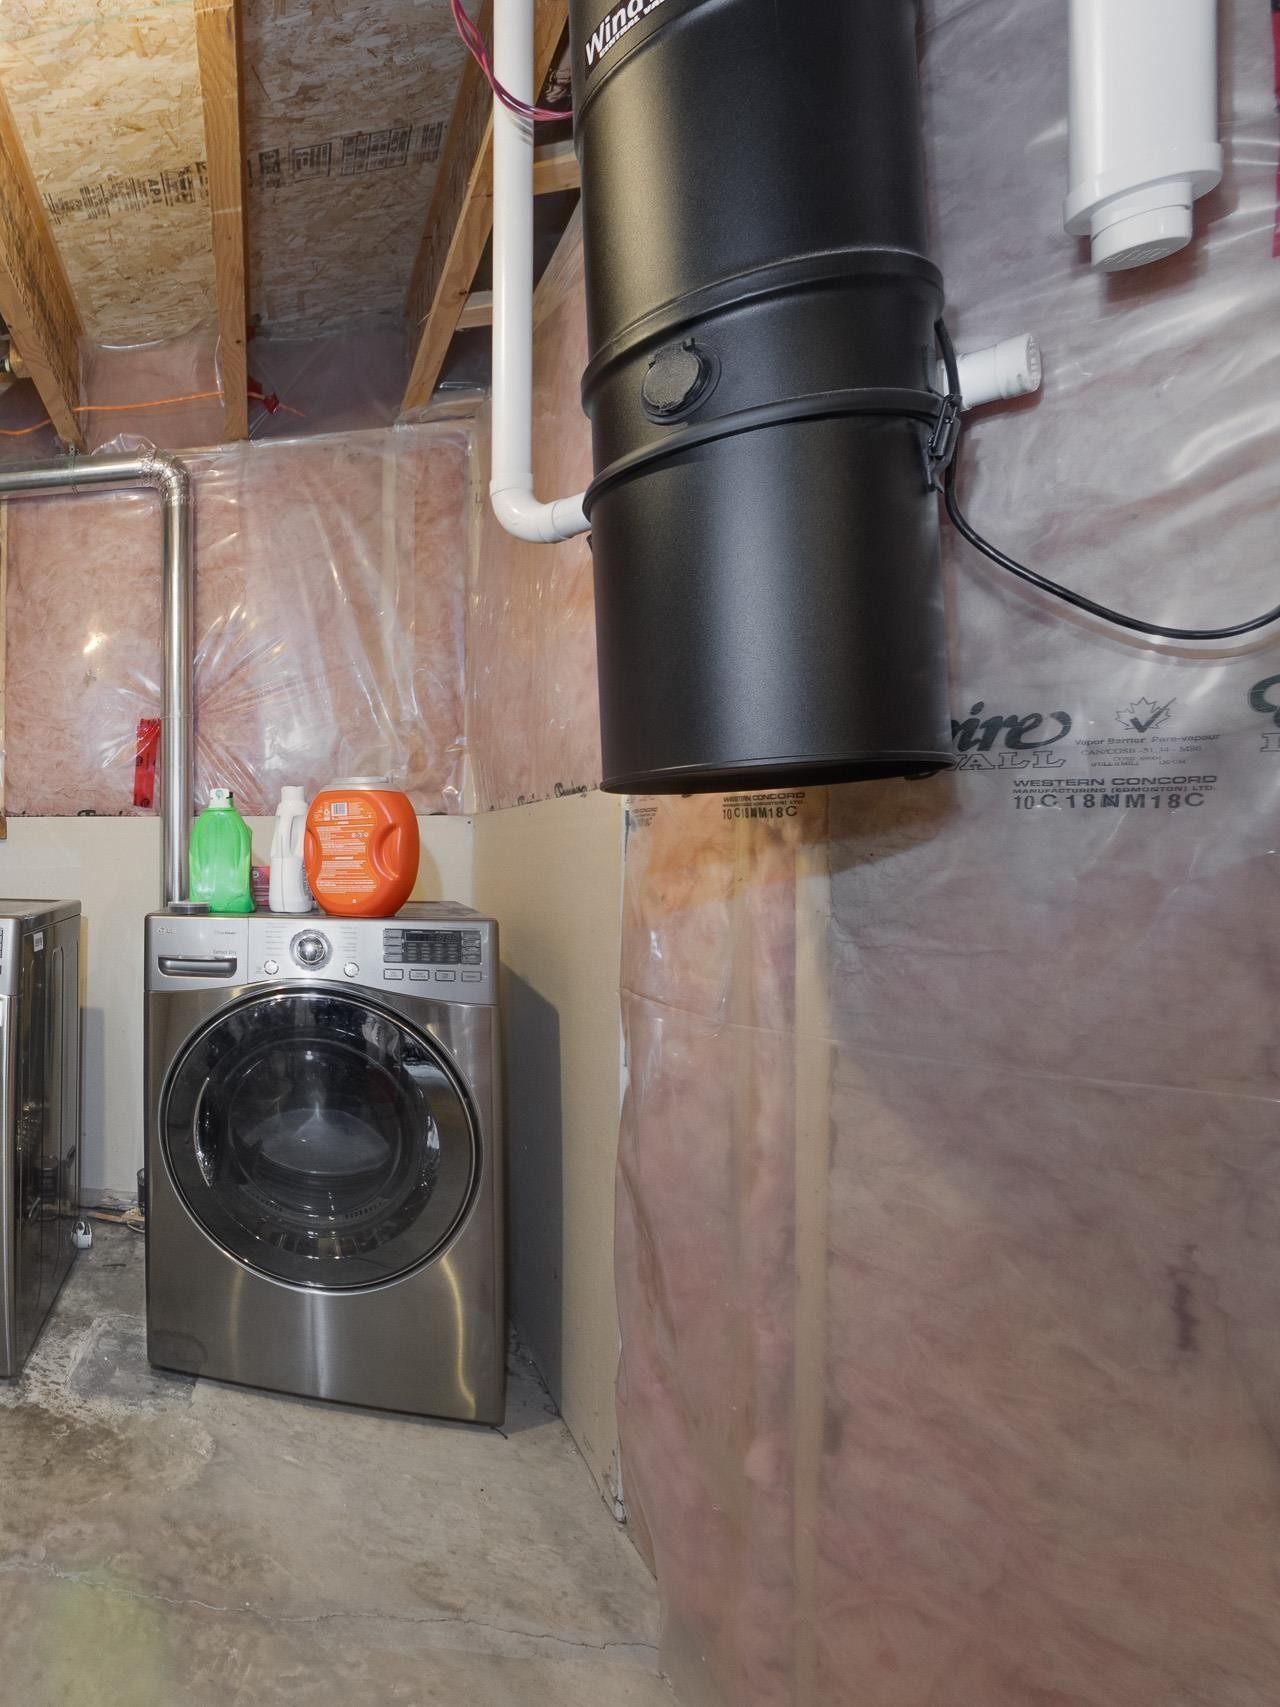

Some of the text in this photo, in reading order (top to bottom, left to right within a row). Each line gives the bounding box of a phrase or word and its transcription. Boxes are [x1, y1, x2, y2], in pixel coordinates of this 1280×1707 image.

[586, 0, 656, 66] Wind
[1013, 775, 1218, 788] WESTERN CONCORD
[752, 792, 806, 801] CONCORD
